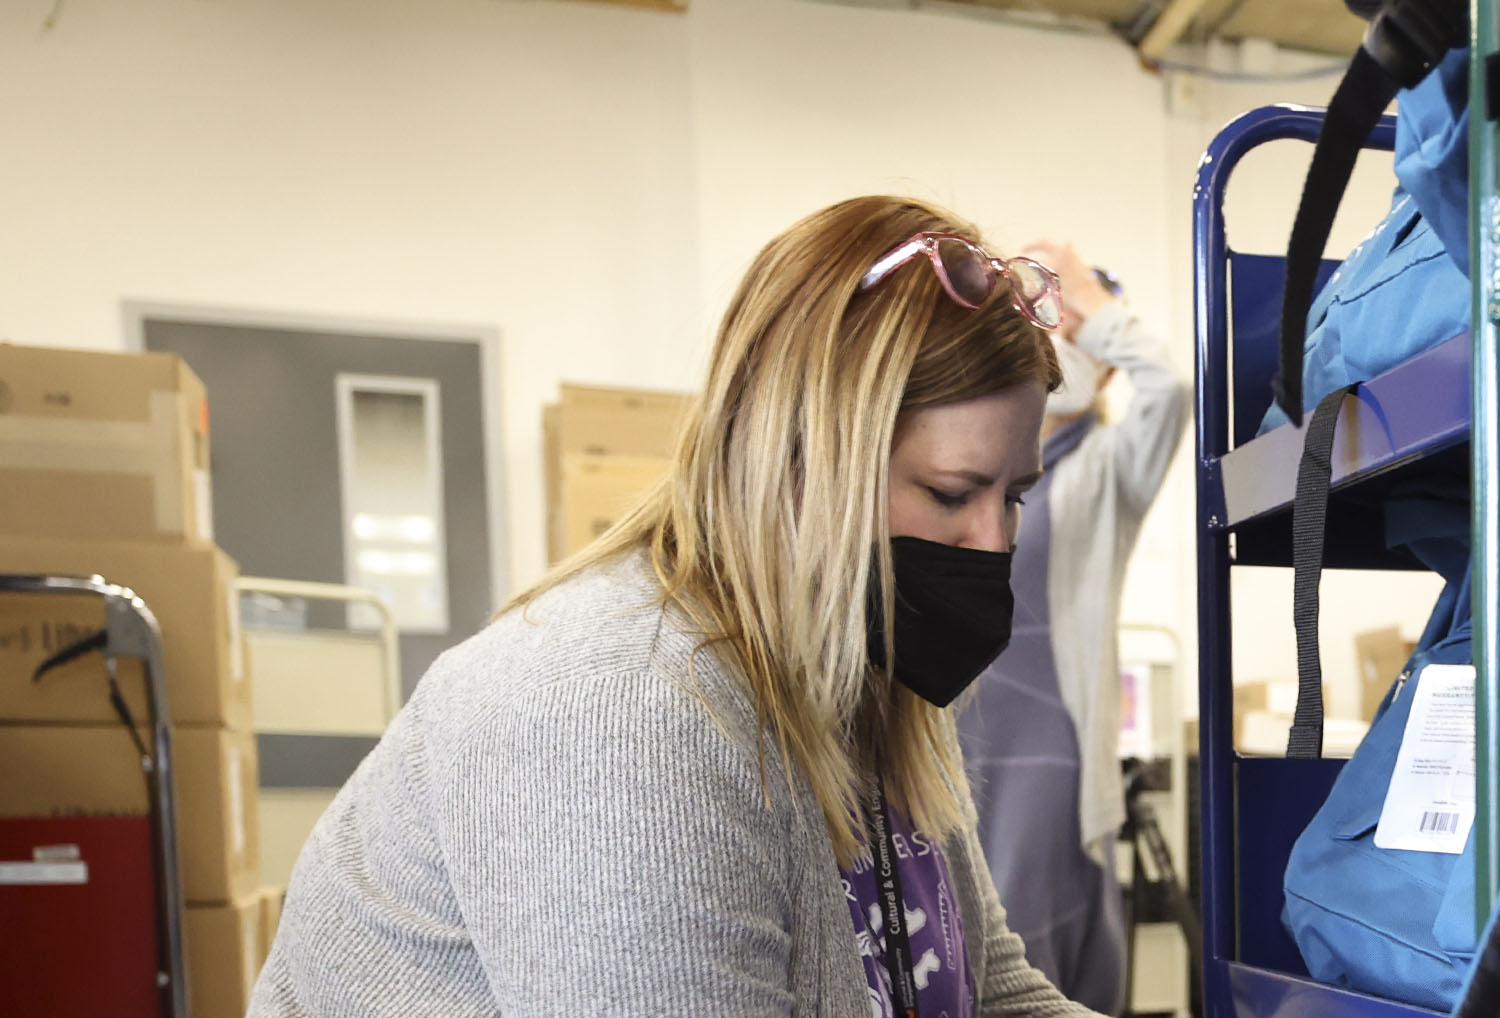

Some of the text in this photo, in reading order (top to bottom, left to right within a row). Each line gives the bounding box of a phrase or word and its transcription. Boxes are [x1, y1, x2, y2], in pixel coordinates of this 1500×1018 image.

[875, 813, 891, 877] Community
[883, 879, 894, 890] &
[884, 891, 900, 935] Cultural
